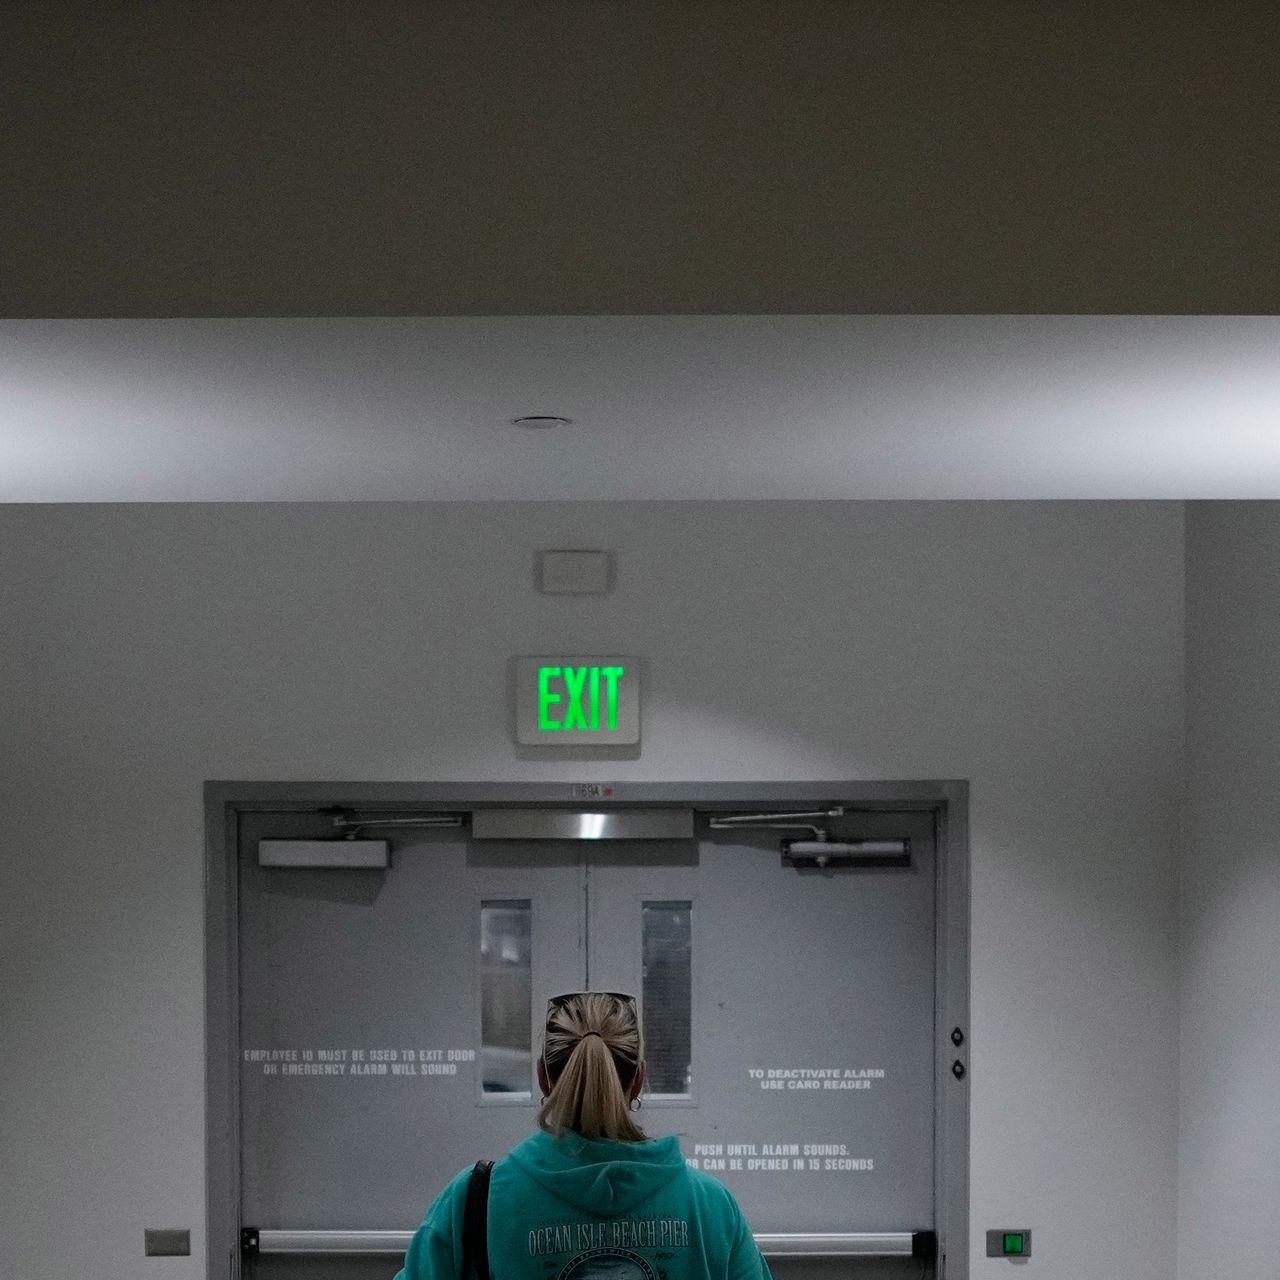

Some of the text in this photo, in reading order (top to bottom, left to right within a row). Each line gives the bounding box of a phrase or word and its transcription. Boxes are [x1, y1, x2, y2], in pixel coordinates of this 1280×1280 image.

[538, 666, 624, 730] EXIT
[244, 1050, 475, 1061] EMPLOYEE ID MUST BE USED TO EXIT DOOR
[263, 1064, 457, 1075] OR EMERGENCY ALARM WILL SOUND
[748, 1069, 885, 1078] TO DEACTIVATE ALARM
[761, 1080, 871, 1089] USE CARD READER
[695, 1144, 850, 1156] PUSH UNTIL ALARM SOUNDS.
[703, 1159, 726, 1170] CAN
[730, 1159, 744, 1170] BE
[748, 1159, 788, 1170] OPENED
[793, 1159, 804, 1170] IN
[809, 1159, 821, 1170] 15
[825, 1159, 874, 1170] SECONDS
[528, 1220, 689, 1256] OCEAN ISLE BEACH PIER
